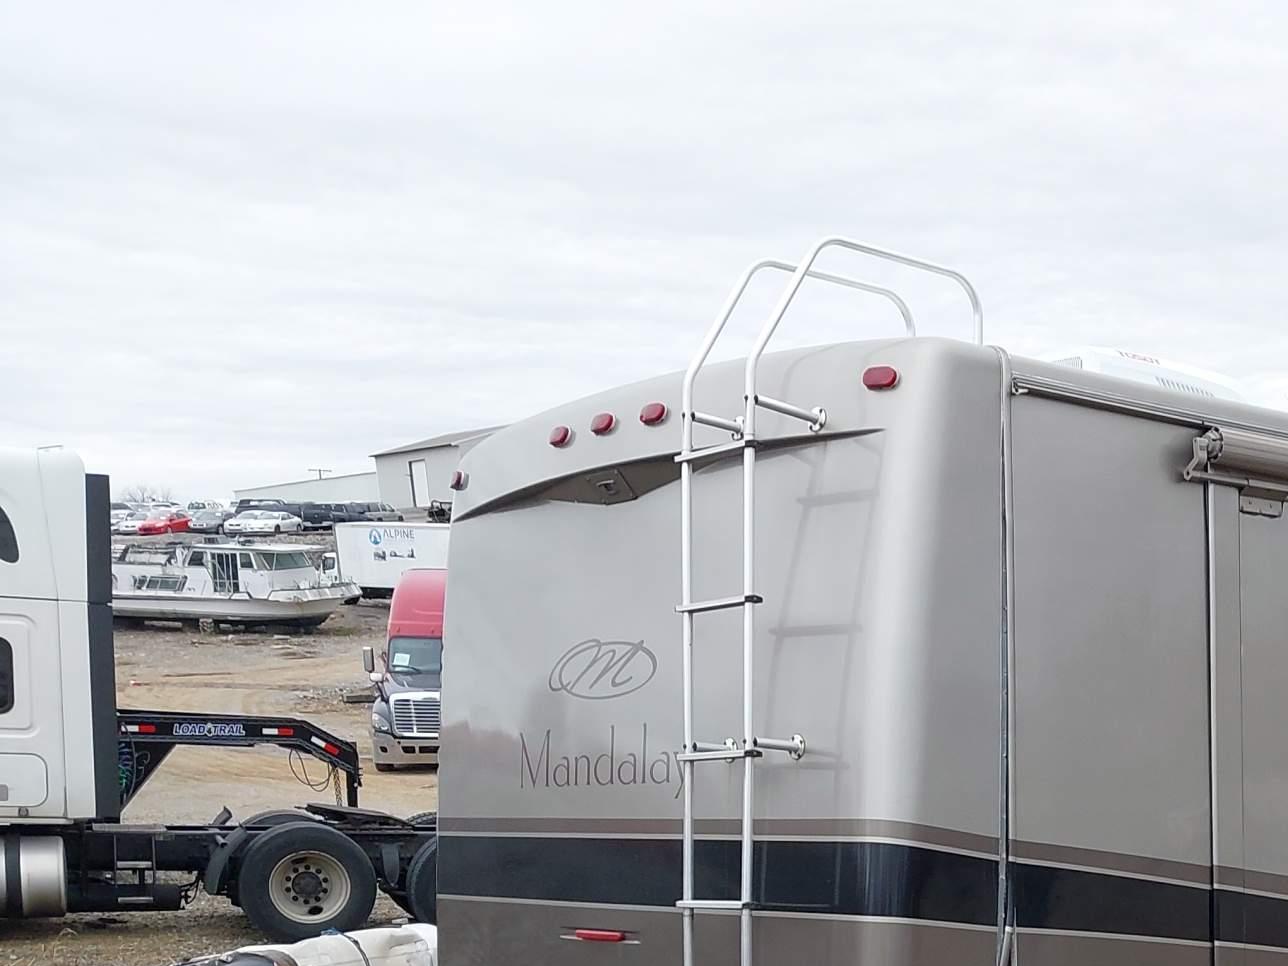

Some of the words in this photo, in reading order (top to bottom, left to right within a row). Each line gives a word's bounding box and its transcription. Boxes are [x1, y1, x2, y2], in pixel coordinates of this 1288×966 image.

[383, 528, 415, 540] ALPINE
[173, 723, 206, 736] LOAD
[212, 723, 246, 736] TRAIL
[519, 722, 685, 800] Mandalay
